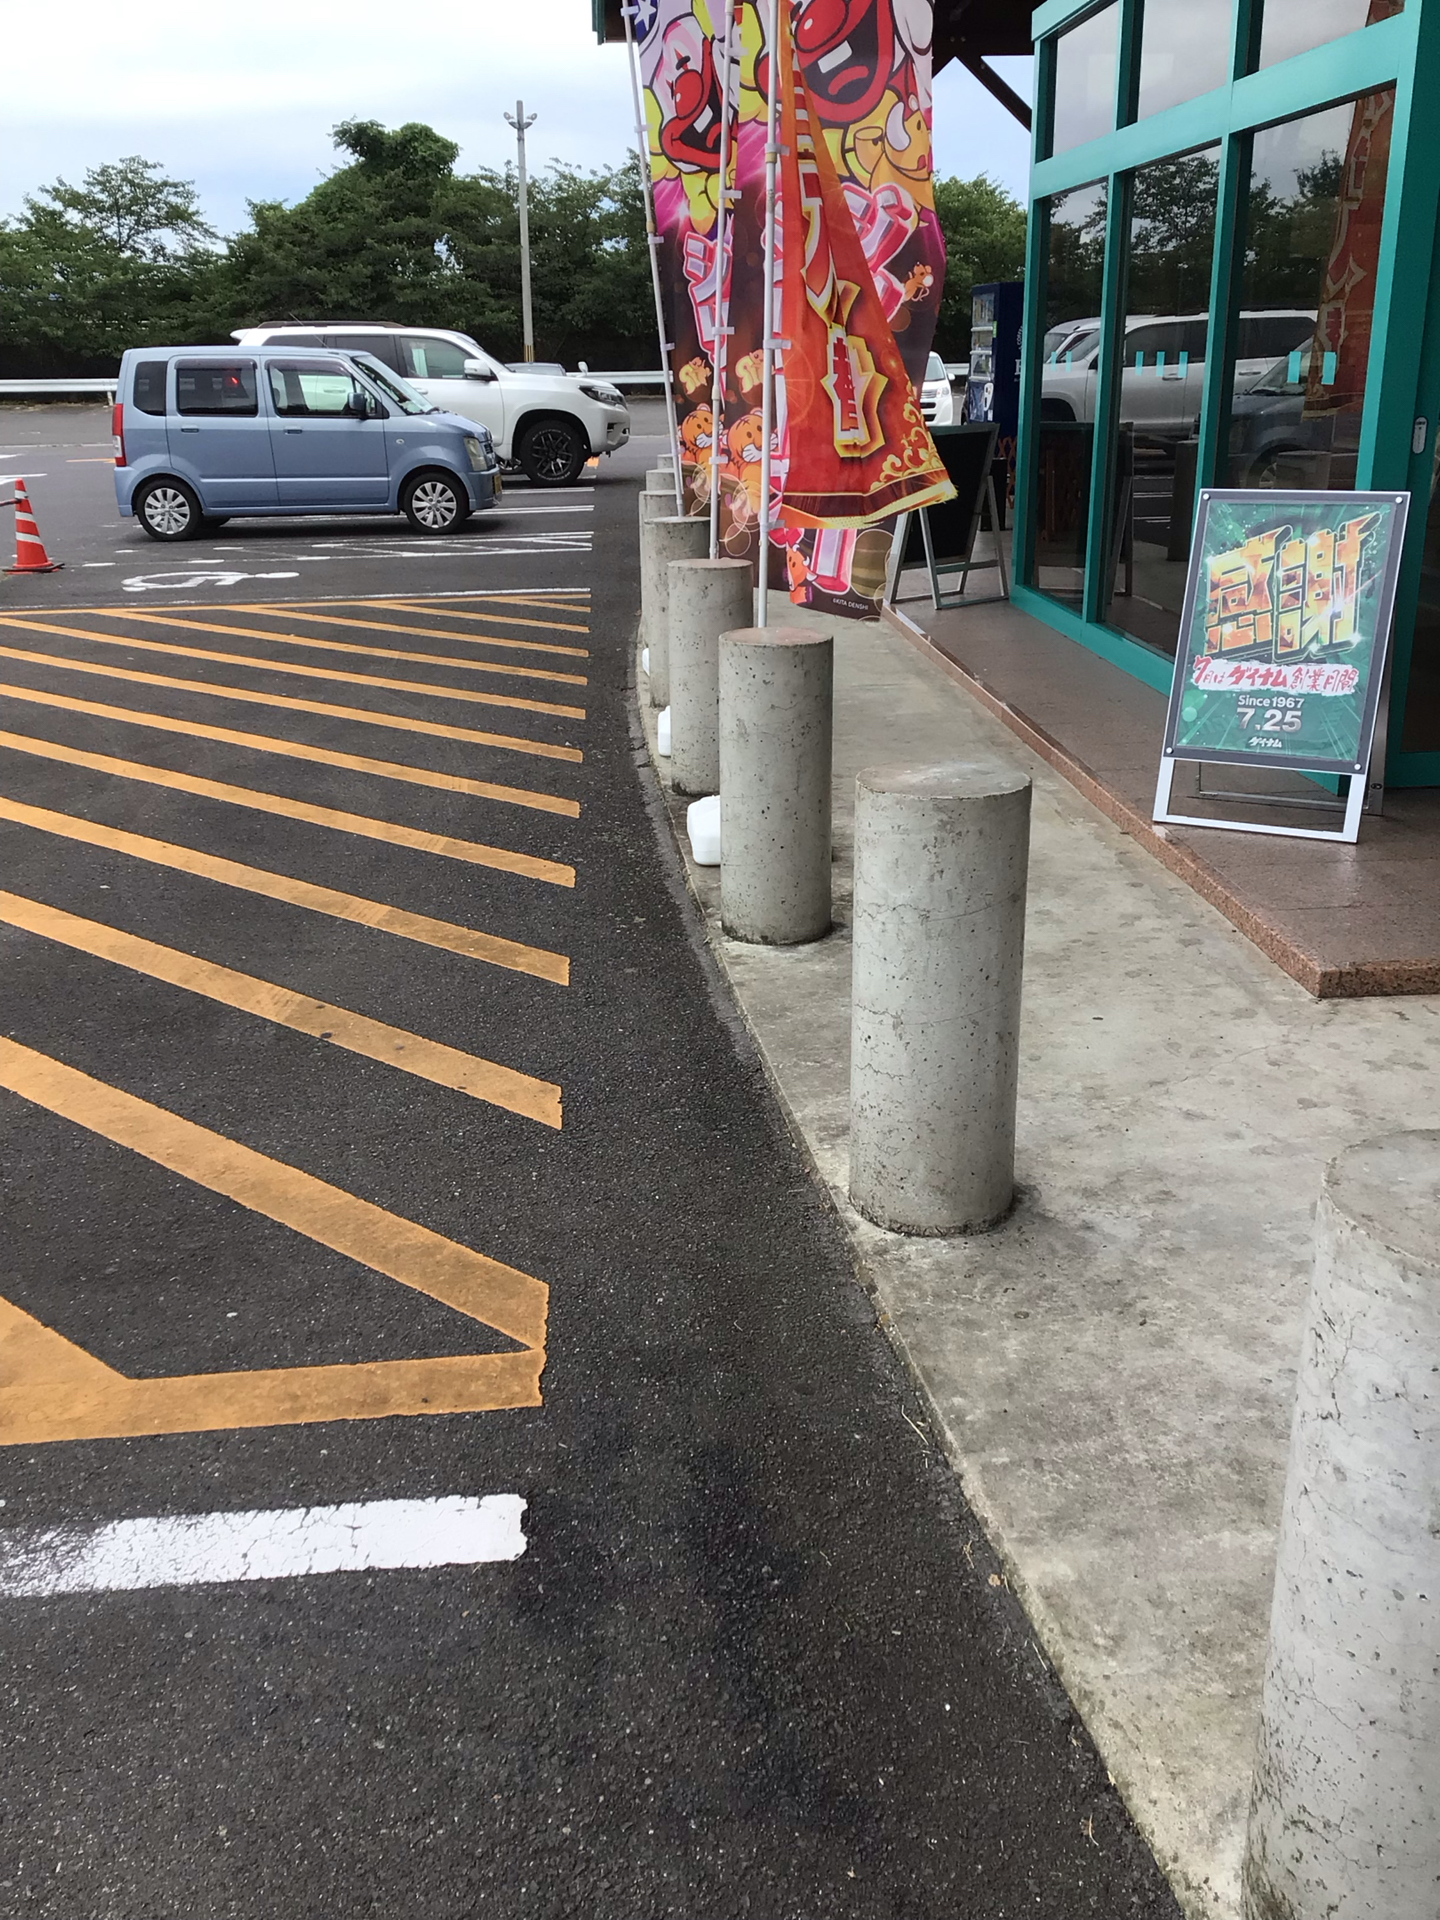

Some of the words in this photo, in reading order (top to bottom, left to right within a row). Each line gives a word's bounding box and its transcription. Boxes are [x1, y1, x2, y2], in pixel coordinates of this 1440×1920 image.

[1204, 512, 1381, 659] 感謝
[848, 601, 869, 610] DENSHI
[1238, 695, 1270, 707] Since
[1272, 697, 1304, 708] 1967
[1237, 708, 1302, 733] 7.25
[1249, 737, 1282, 748] ダイナム
